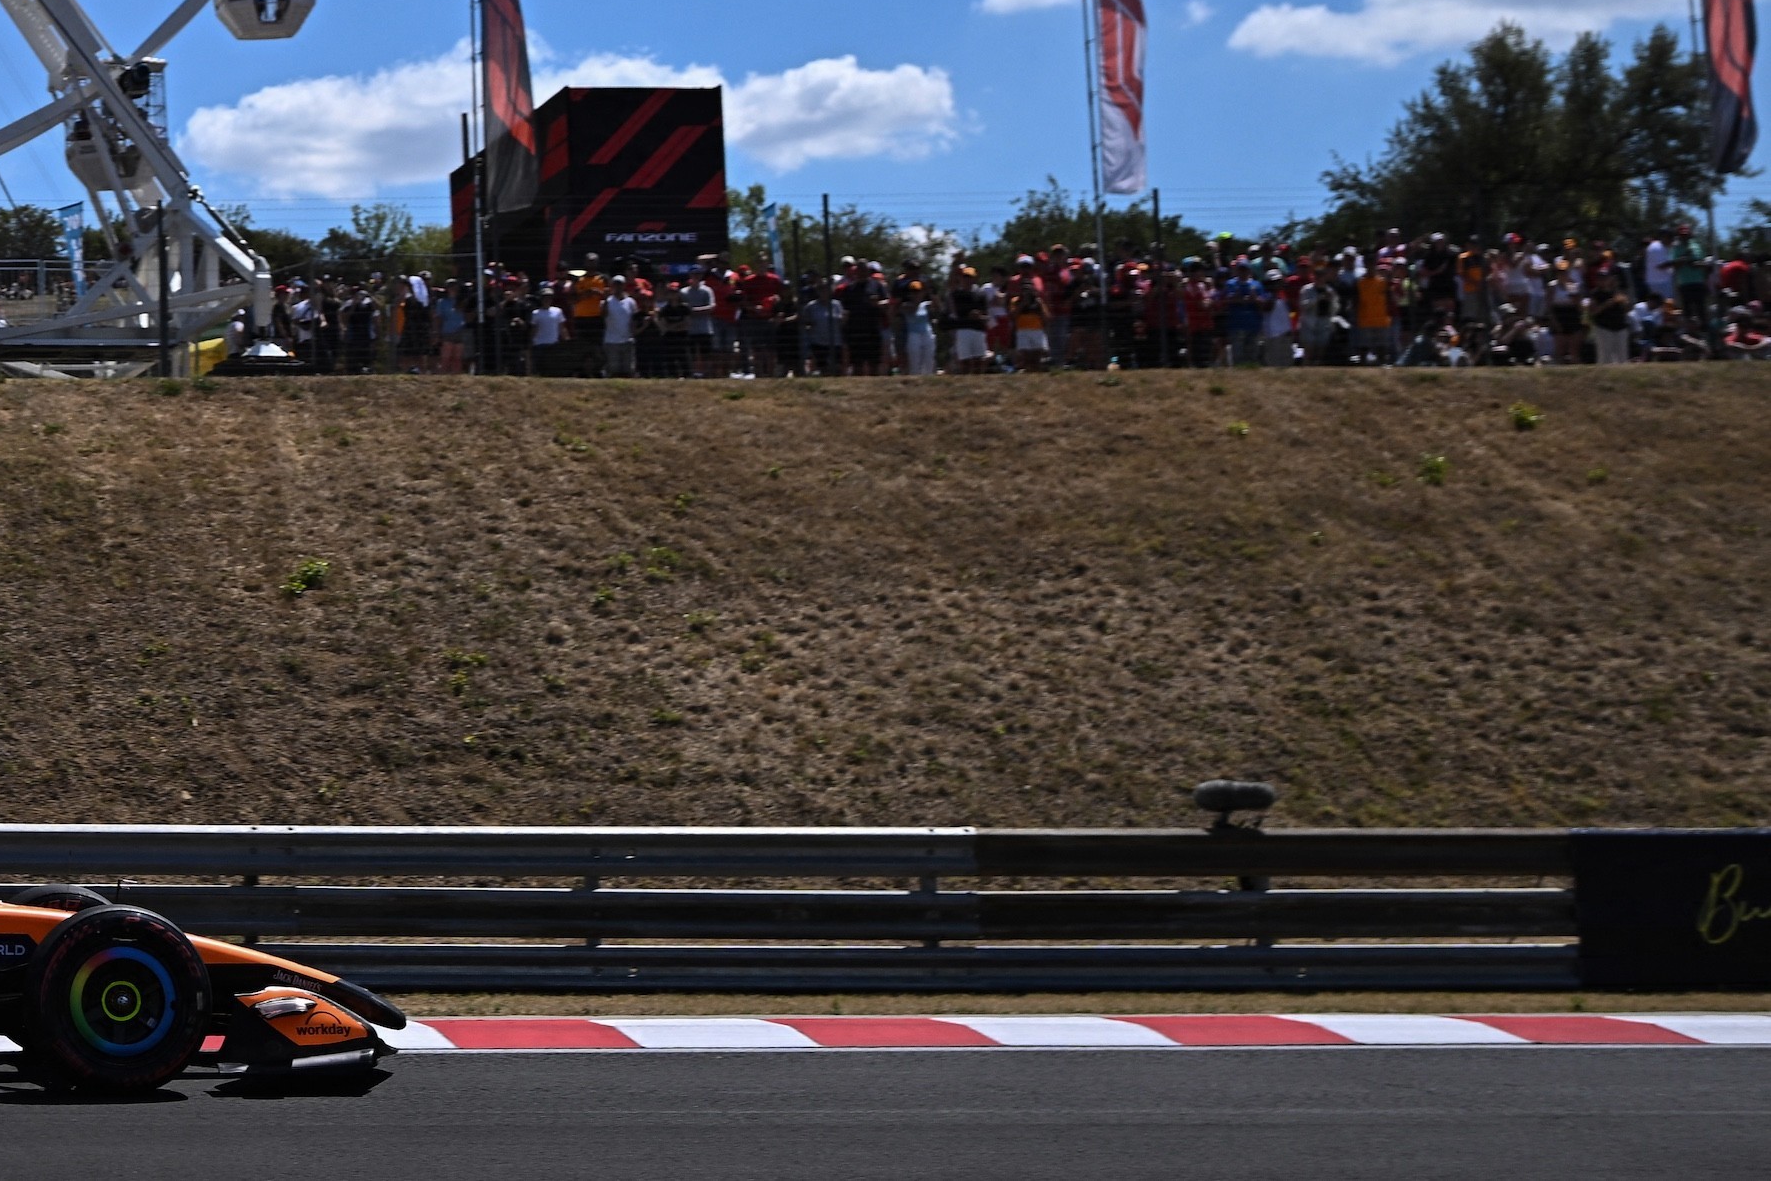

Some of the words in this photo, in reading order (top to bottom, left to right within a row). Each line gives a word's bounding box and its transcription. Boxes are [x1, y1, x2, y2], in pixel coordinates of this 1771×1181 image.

[604, 232, 699, 243] FANZONE
[273, 970, 293, 984] JACK
[296, 1024, 351, 1038] workday
